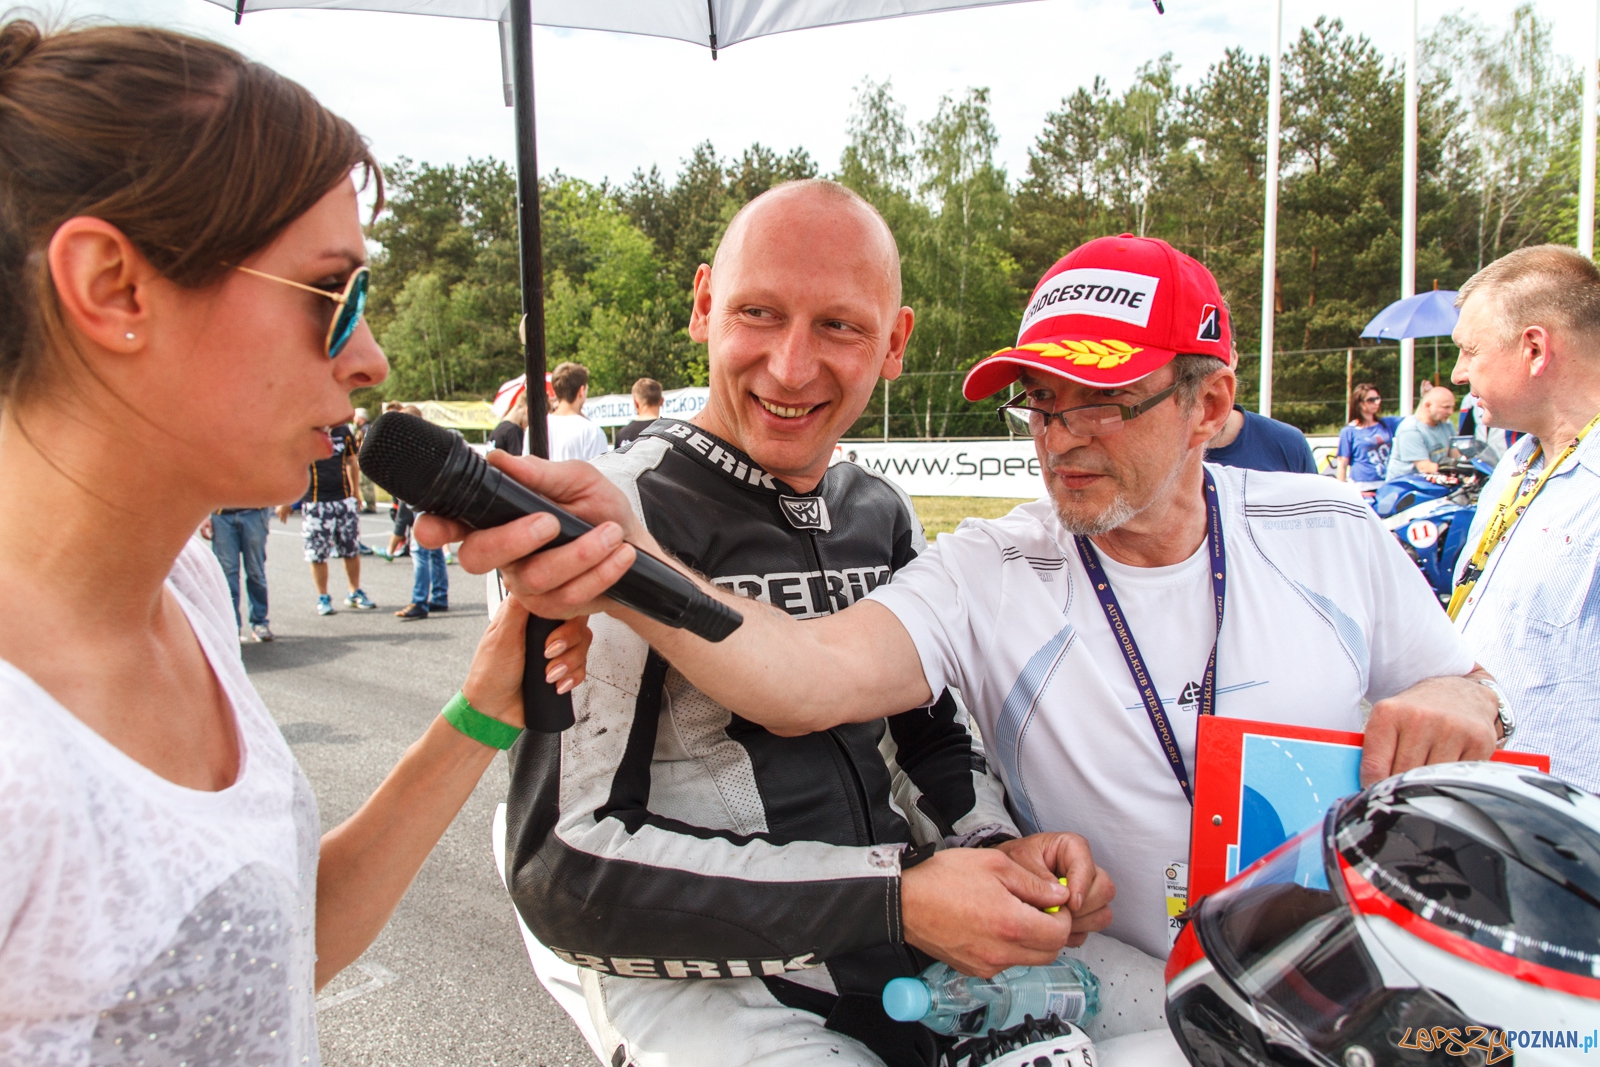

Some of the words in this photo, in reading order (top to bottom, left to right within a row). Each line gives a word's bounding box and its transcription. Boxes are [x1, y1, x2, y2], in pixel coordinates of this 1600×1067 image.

[1262, 519, 1302, 530] SPORTS
[1305, 517, 1335, 529] WEAR
[1412, 524, 1430, 541] 11
[1106, 603, 1148, 687] AUTOMOBILKLUB
[1144, 687, 1179, 764] WIELKOPOLSKI
